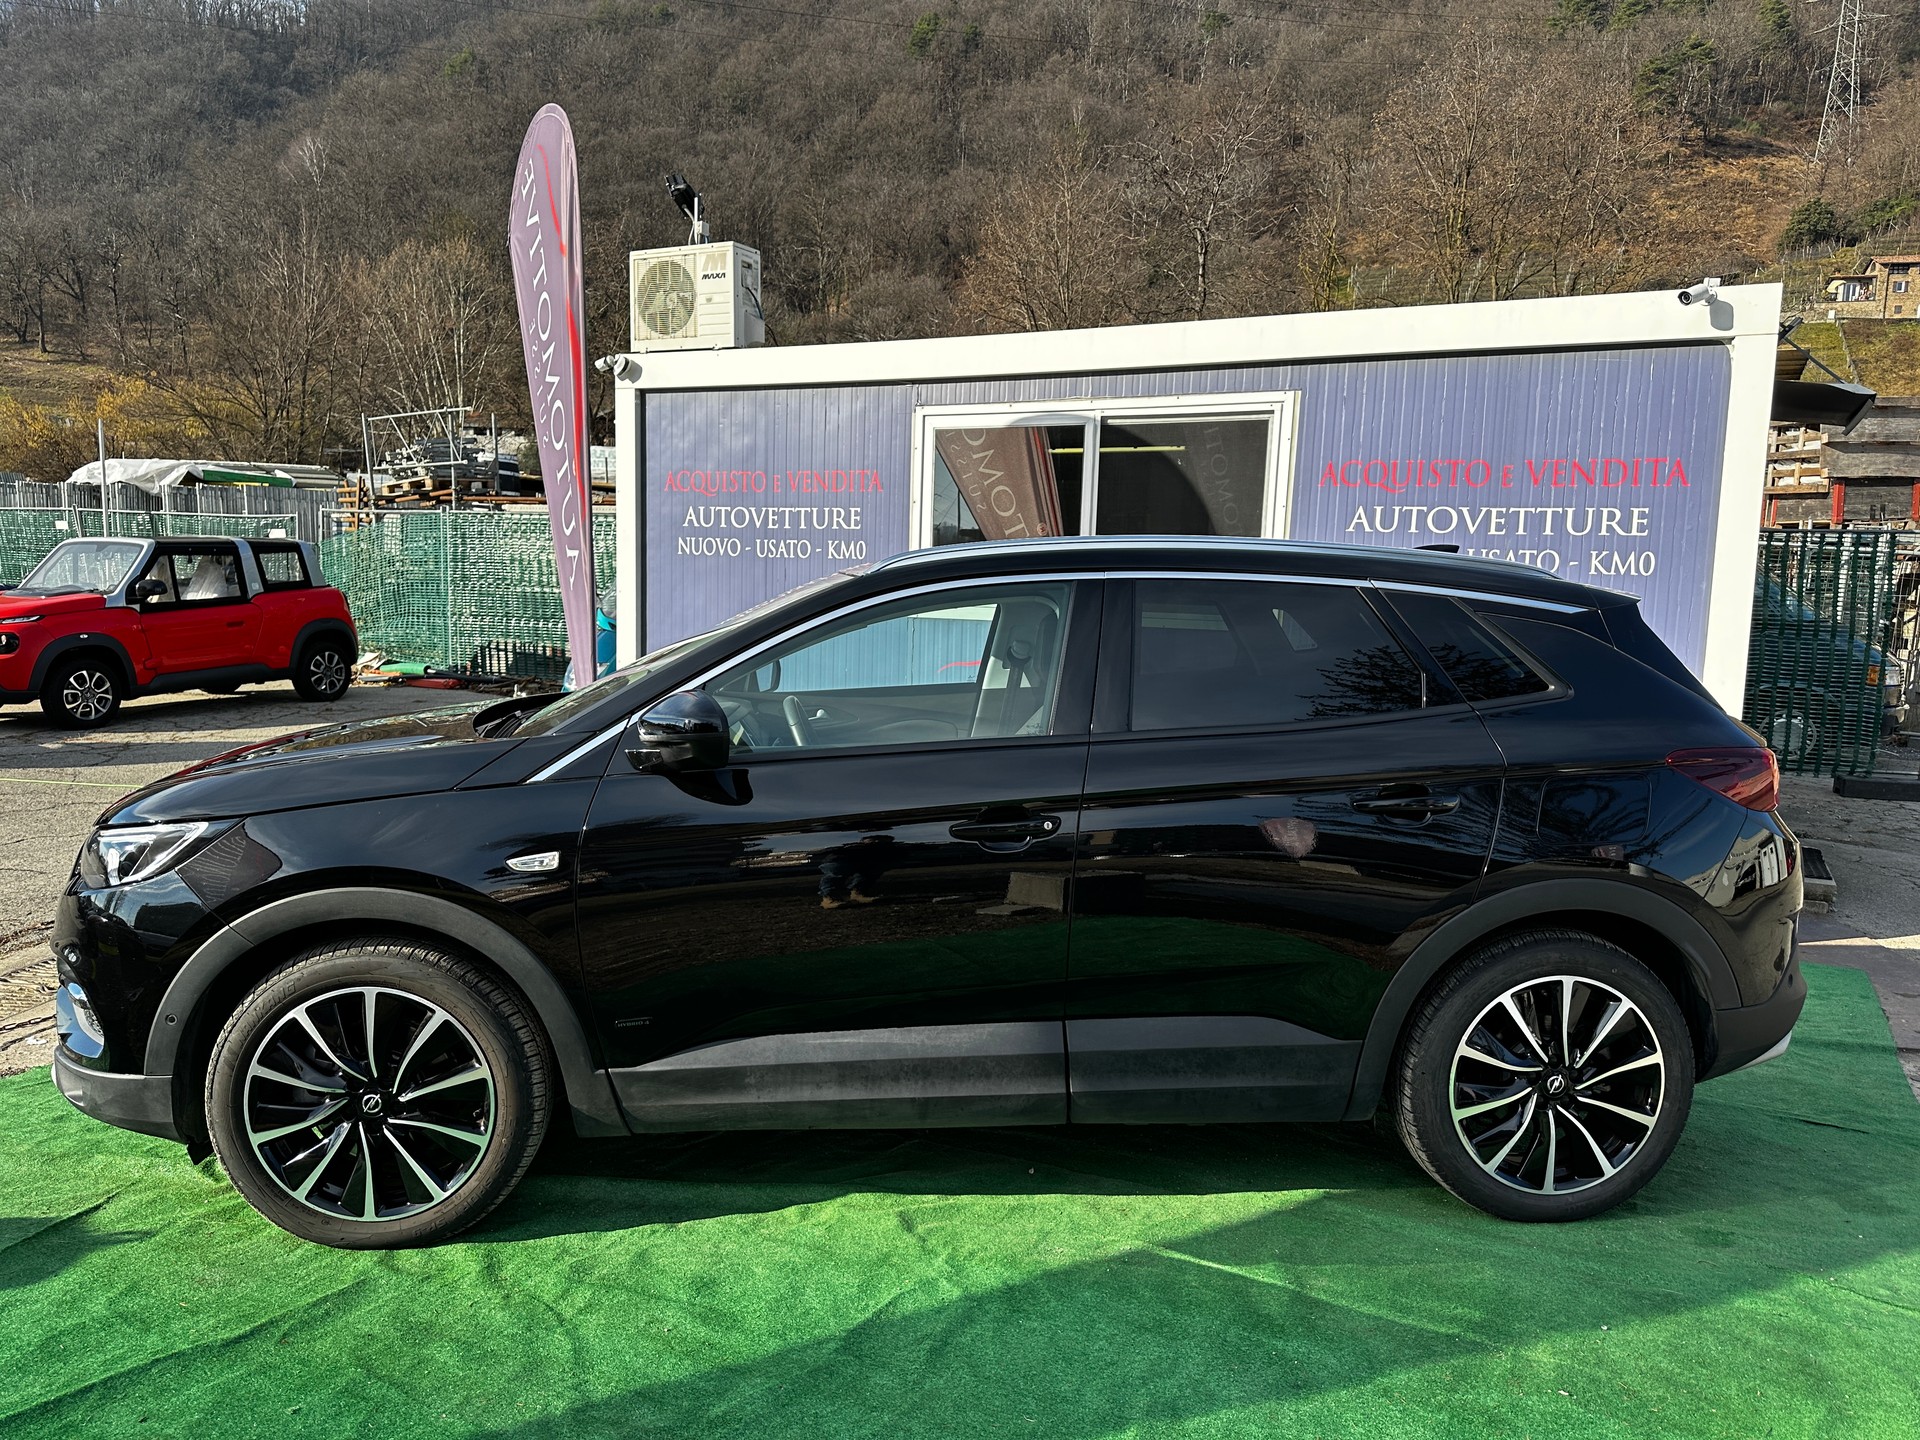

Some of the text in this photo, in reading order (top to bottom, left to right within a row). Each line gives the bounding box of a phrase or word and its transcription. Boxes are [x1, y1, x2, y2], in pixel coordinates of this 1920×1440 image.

[664, 470, 767, 496] ACQUISTO
[787, 470, 884, 493] VENDITA
[1317, 459, 1491, 493] ACQUISTO
[1525, 457, 1691, 487] VENDITA
[683, 506, 861, 530] AUTOVETTURE
[1346, 505, 1649, 536] AUTOVETTURE
[677, 537, 741, 557] NUOVO
[756, 539, 812, 559] USATO
[827, 540, 867, 560] KM0
[1588, 550, 1656, 576] KM0
